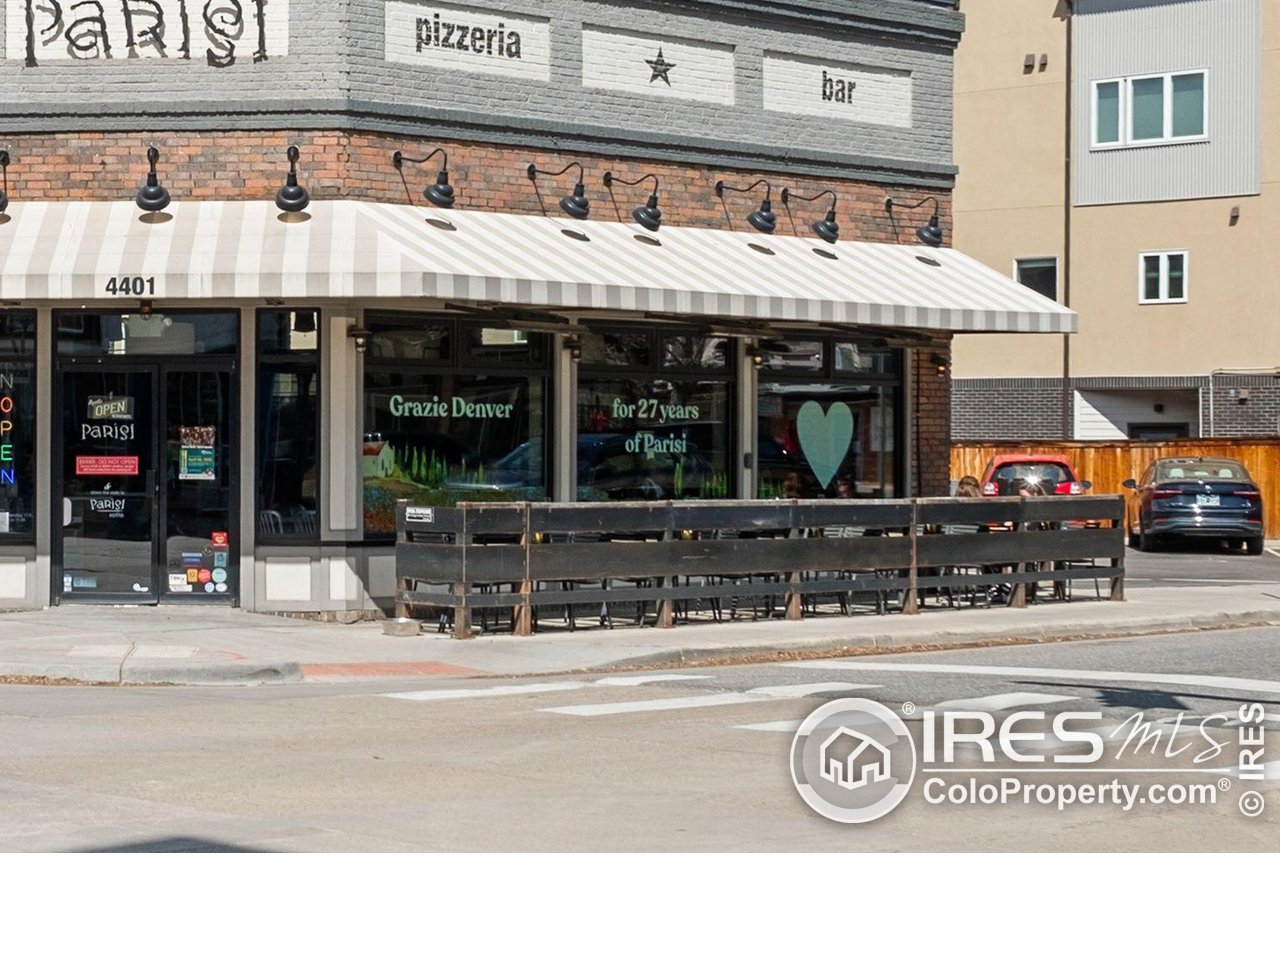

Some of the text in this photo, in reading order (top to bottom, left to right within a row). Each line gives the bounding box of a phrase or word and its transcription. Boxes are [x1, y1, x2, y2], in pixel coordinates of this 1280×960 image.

[416, 13, 522, 59] pizzeria
[822, 70, 856, 104] bar
[105, 276, 155, 296] 4401
[95, 400, 125, 417] OPEN
[389, 394, 513, 419] Grazie Denver
[612, 398, 699, 423] for 27 years
[626, 432, 687, 453] of Parisi
